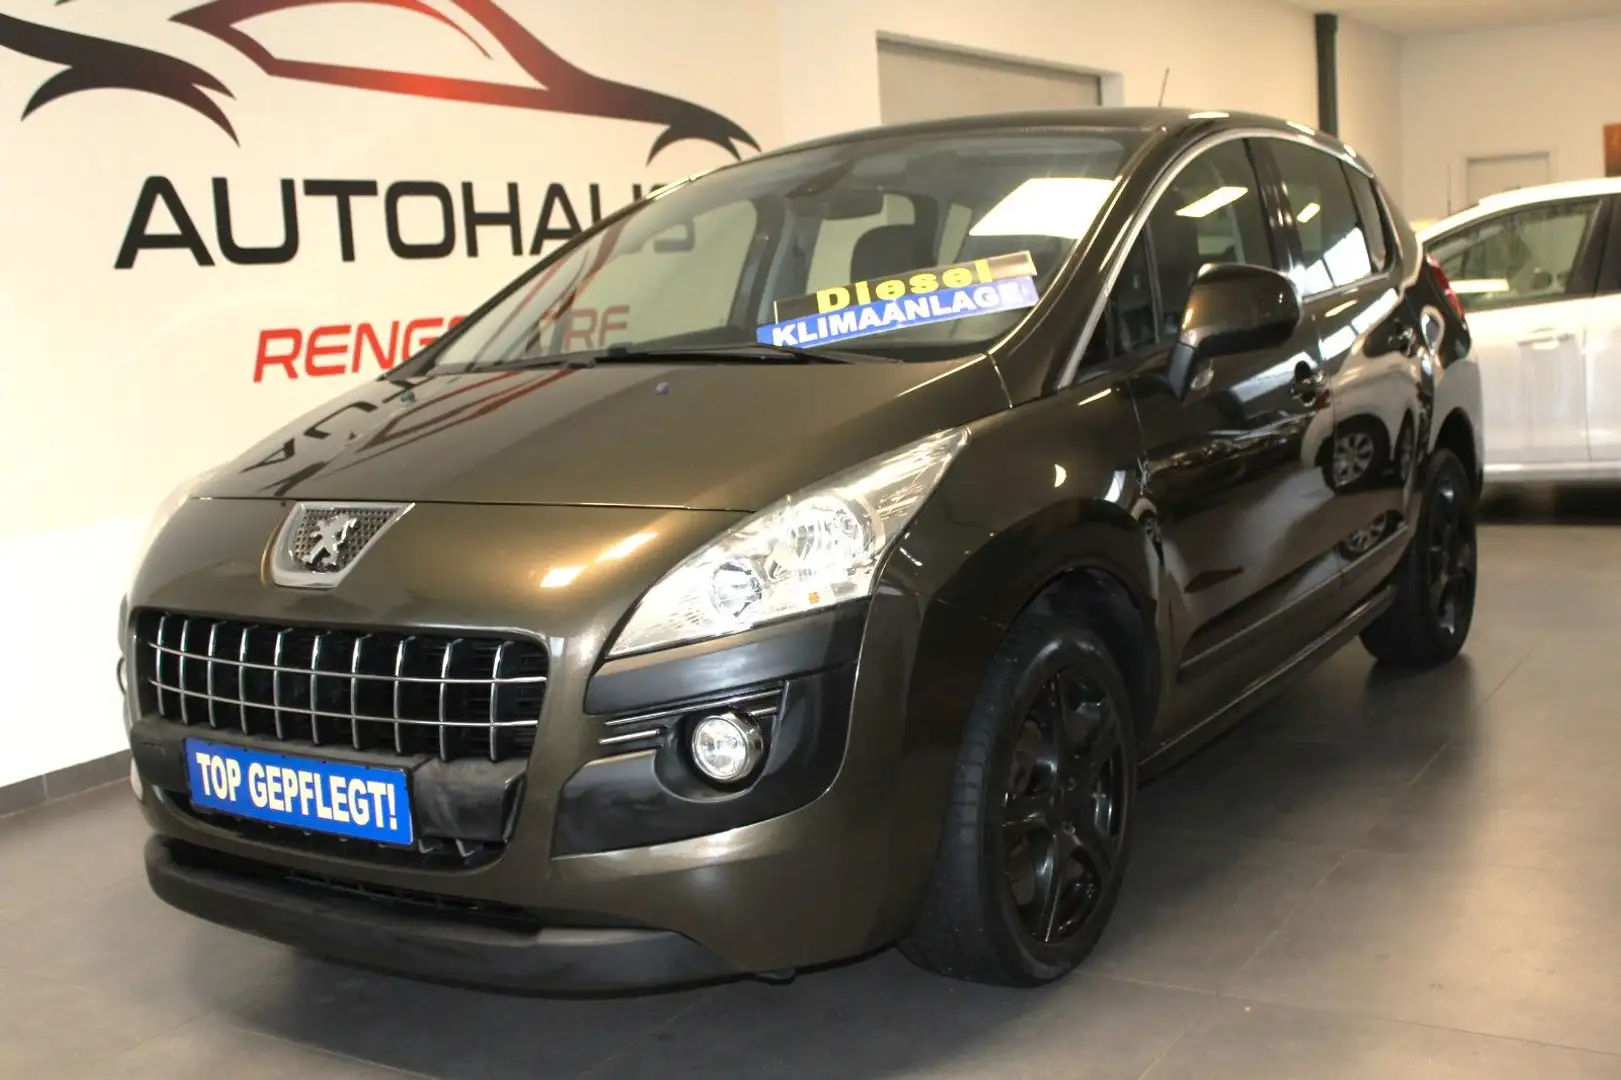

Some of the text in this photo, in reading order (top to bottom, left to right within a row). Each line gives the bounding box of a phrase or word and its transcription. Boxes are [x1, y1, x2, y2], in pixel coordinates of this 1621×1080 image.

[253, 304, 629, 383] RENGRF
[196, 752, 398, 830] TOP GEPFLEGT!
